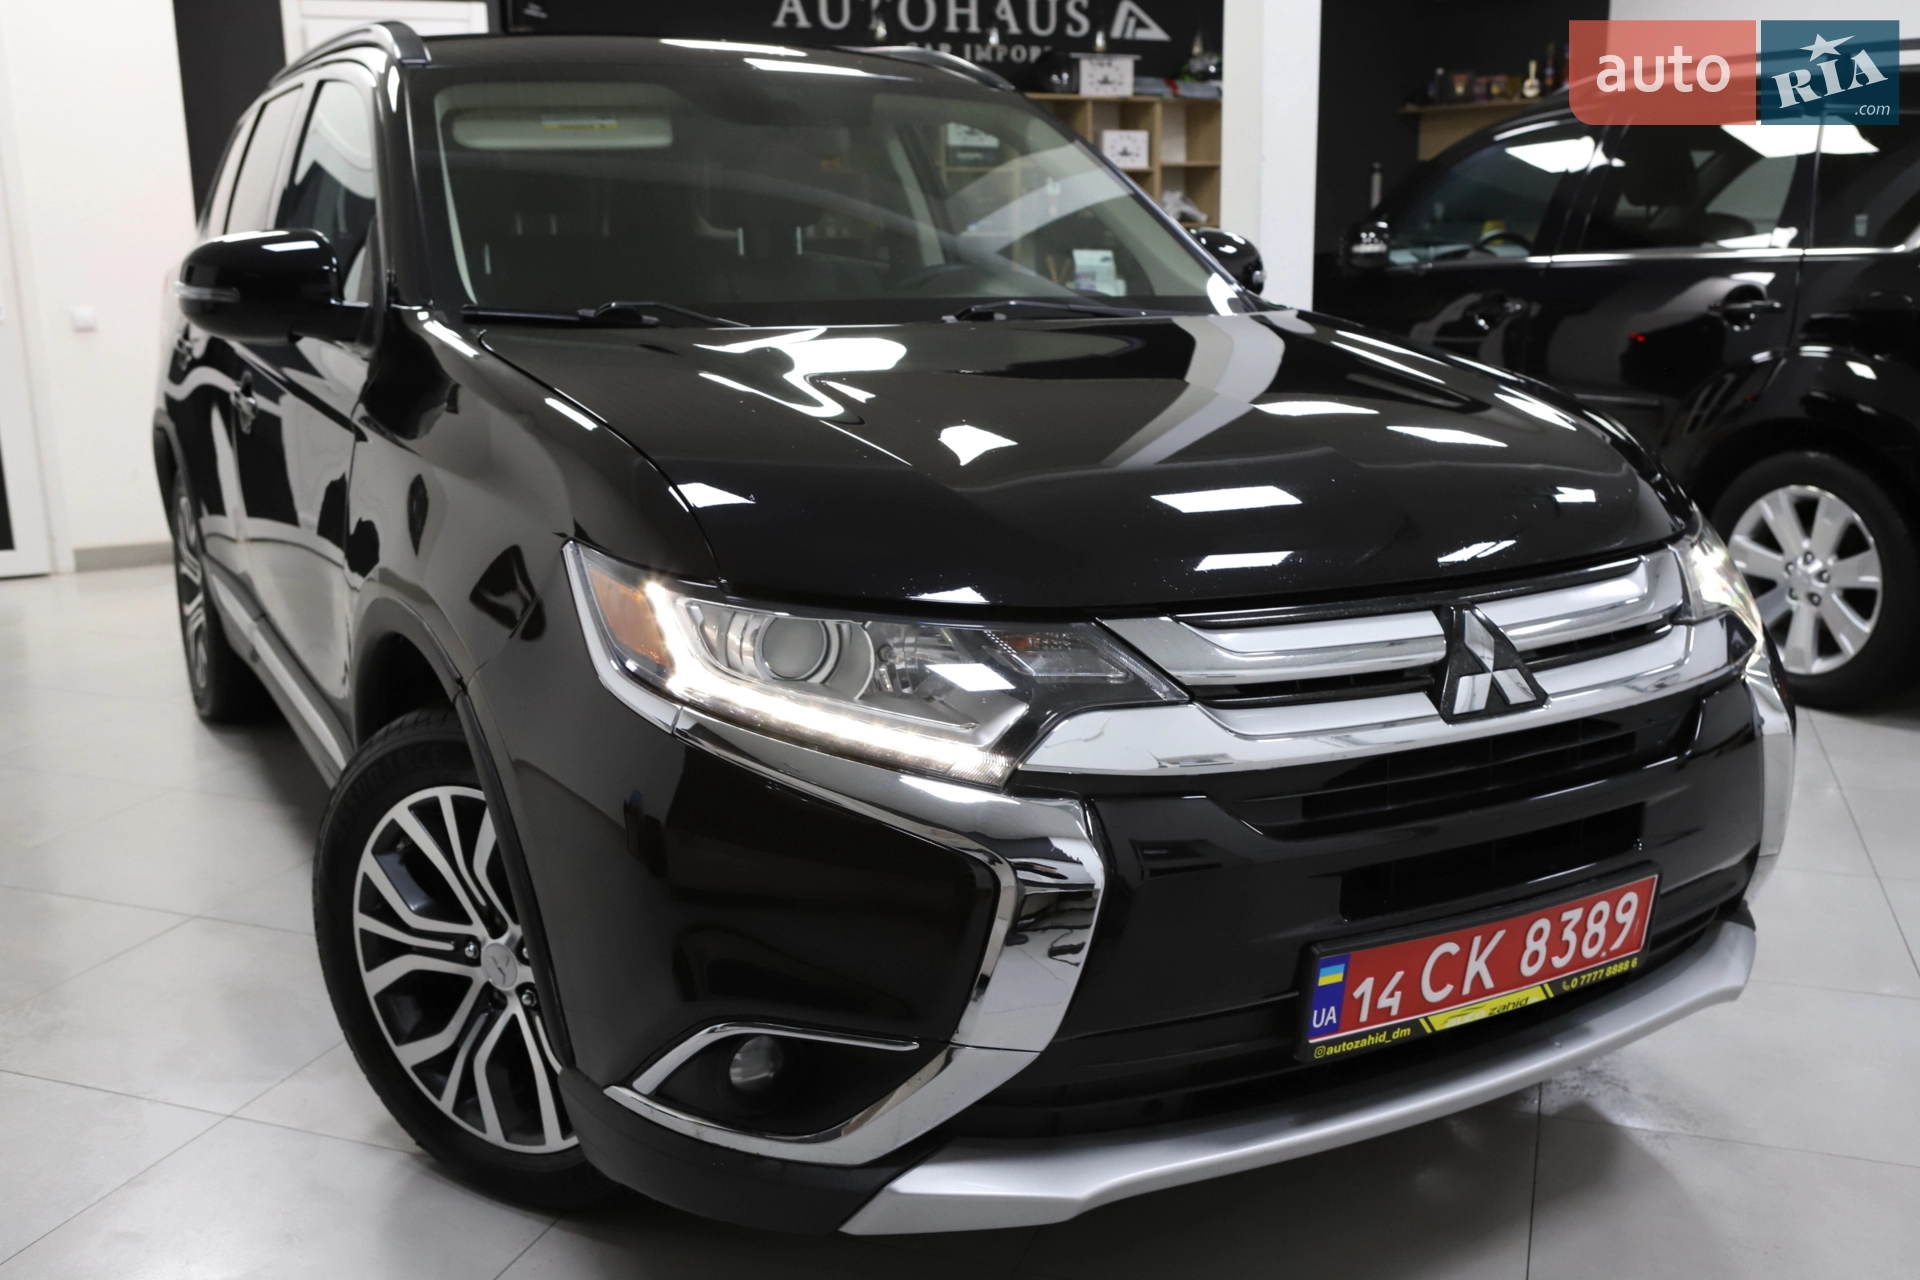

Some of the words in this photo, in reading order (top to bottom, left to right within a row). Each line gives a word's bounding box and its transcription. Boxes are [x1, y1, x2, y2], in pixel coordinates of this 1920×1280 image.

[963, 42, 1053, 64] IMPOR
[1352, 970, 1405, 1023] 14
[1421, 930, 1506, 1003] CK
[1519, 891, 1639, 977] 8389
[1580, 968, 1605, 986] 7777
[1605, 959, 1630, 977] 8888
[1312, 1005, 1337, 1029] UA
[1326, 1027, 1411, 1056] autozahid_dm
